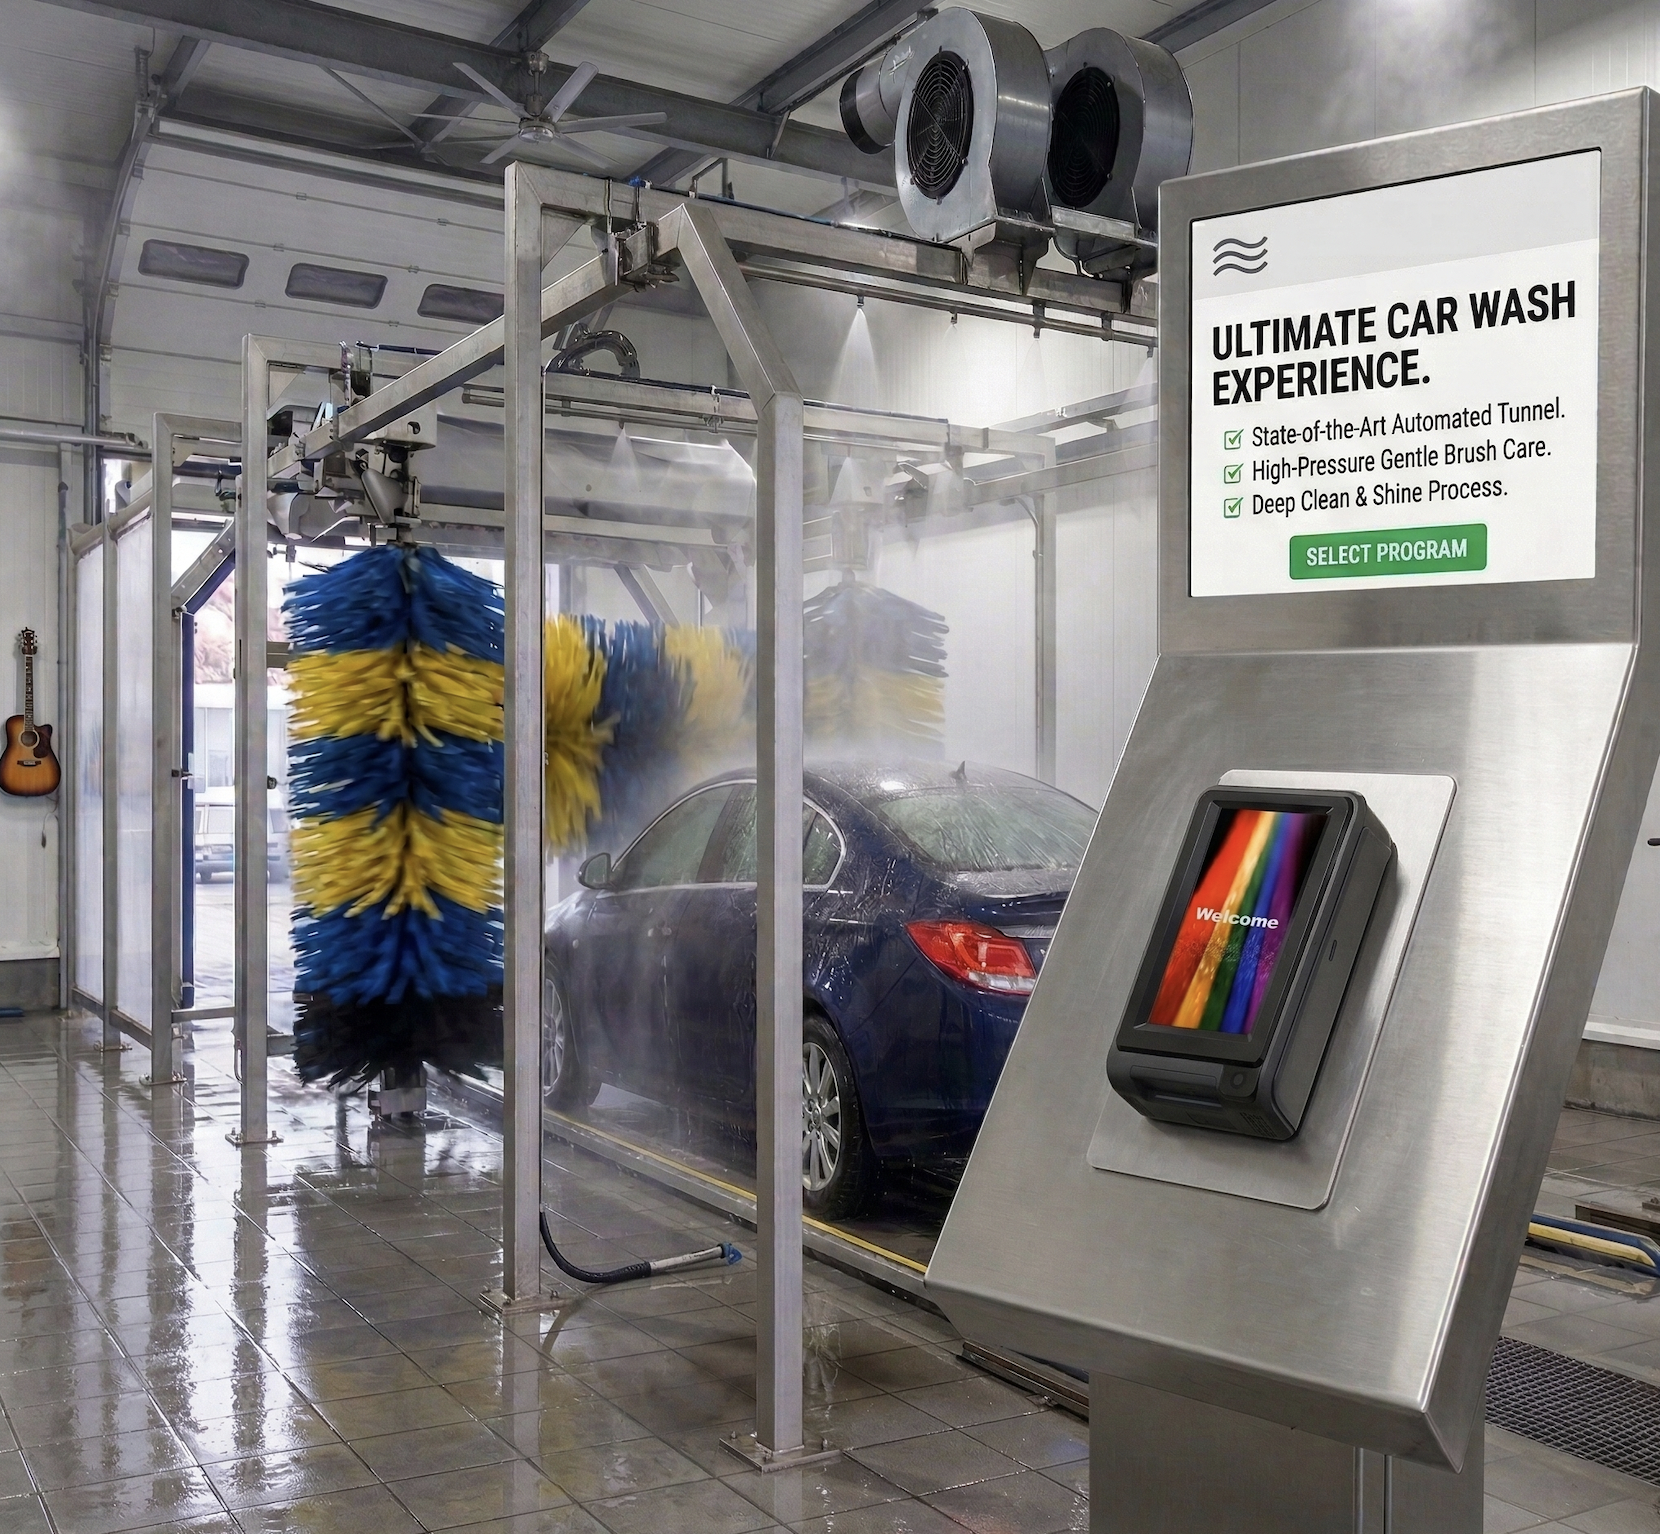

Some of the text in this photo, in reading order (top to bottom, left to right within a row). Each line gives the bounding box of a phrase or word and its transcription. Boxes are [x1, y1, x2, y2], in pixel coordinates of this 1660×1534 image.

[1212, 280, 1576, 360] ULTIMATE CAR WASH
[1212, 349, 1430, 406] EXPERIENCE.
[1252, 397, 1566, 447] State-of-the-Art Automated Tunnel.
[1252, 438, 1551, 484] High-Pressure Gentle Brush Care.
[1252, 480, 1508, 517] Deep Clean & Shine Process.
[1306, 538, 1467, 566] SELECT PROGRAM
[1196, 907, 1279, 929] Welcome
